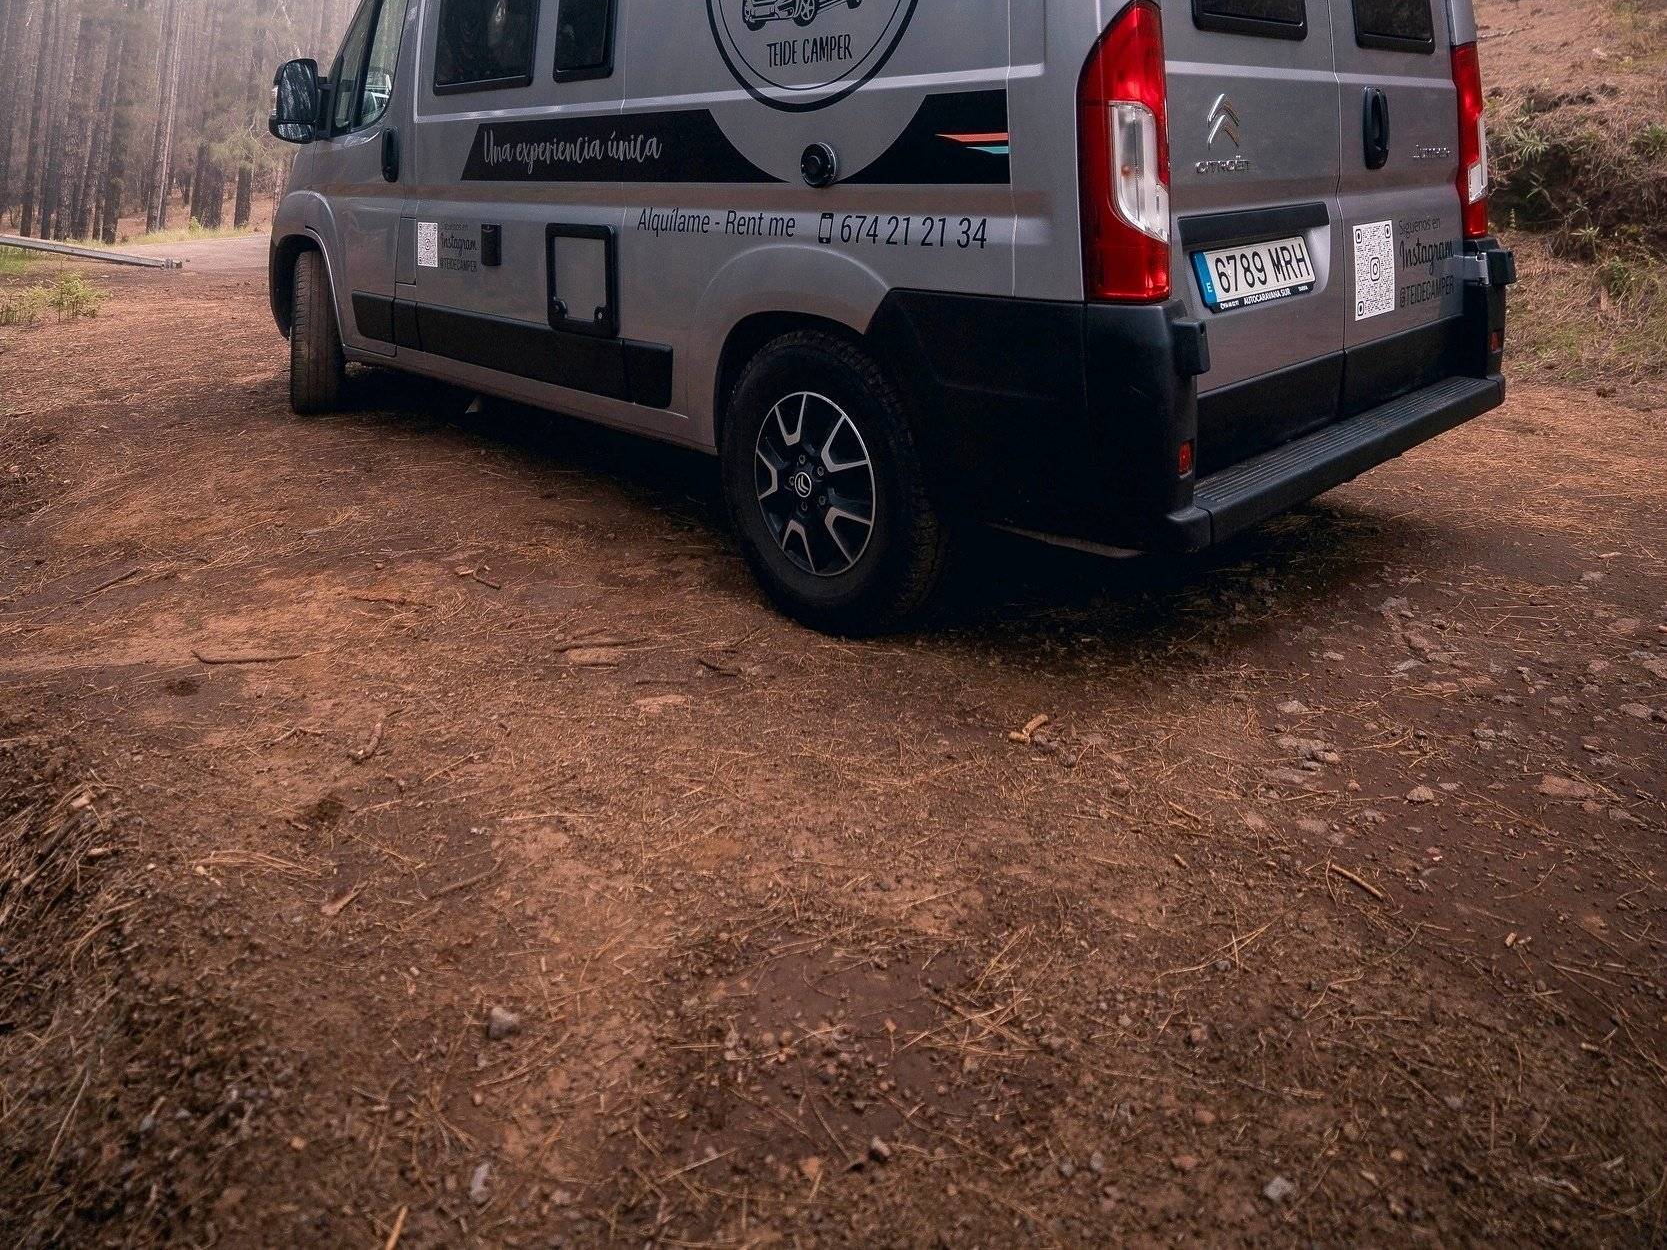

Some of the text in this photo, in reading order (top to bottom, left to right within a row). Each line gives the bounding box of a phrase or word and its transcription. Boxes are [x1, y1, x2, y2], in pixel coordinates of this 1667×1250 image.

[766, 34, 852, 67] TEIDE CAMPER
[484, 129, 662, 174] Una experiencia única
[636, 207, 710, 238] Alquílame
[725, 210, 764, 237] Rent
[768, 216, 796, 238] me
[840, 215, 879, 244] 674
[886, 216, 911, 246] 21
[920, 217, 946, 247] 21
[957, 218, 988, 248] 34
[1214, 243, 1310, 293] 6789 MRH
[1400, 238, 1455, 276] Instagram
[1206, 282, 1213, 293] E
